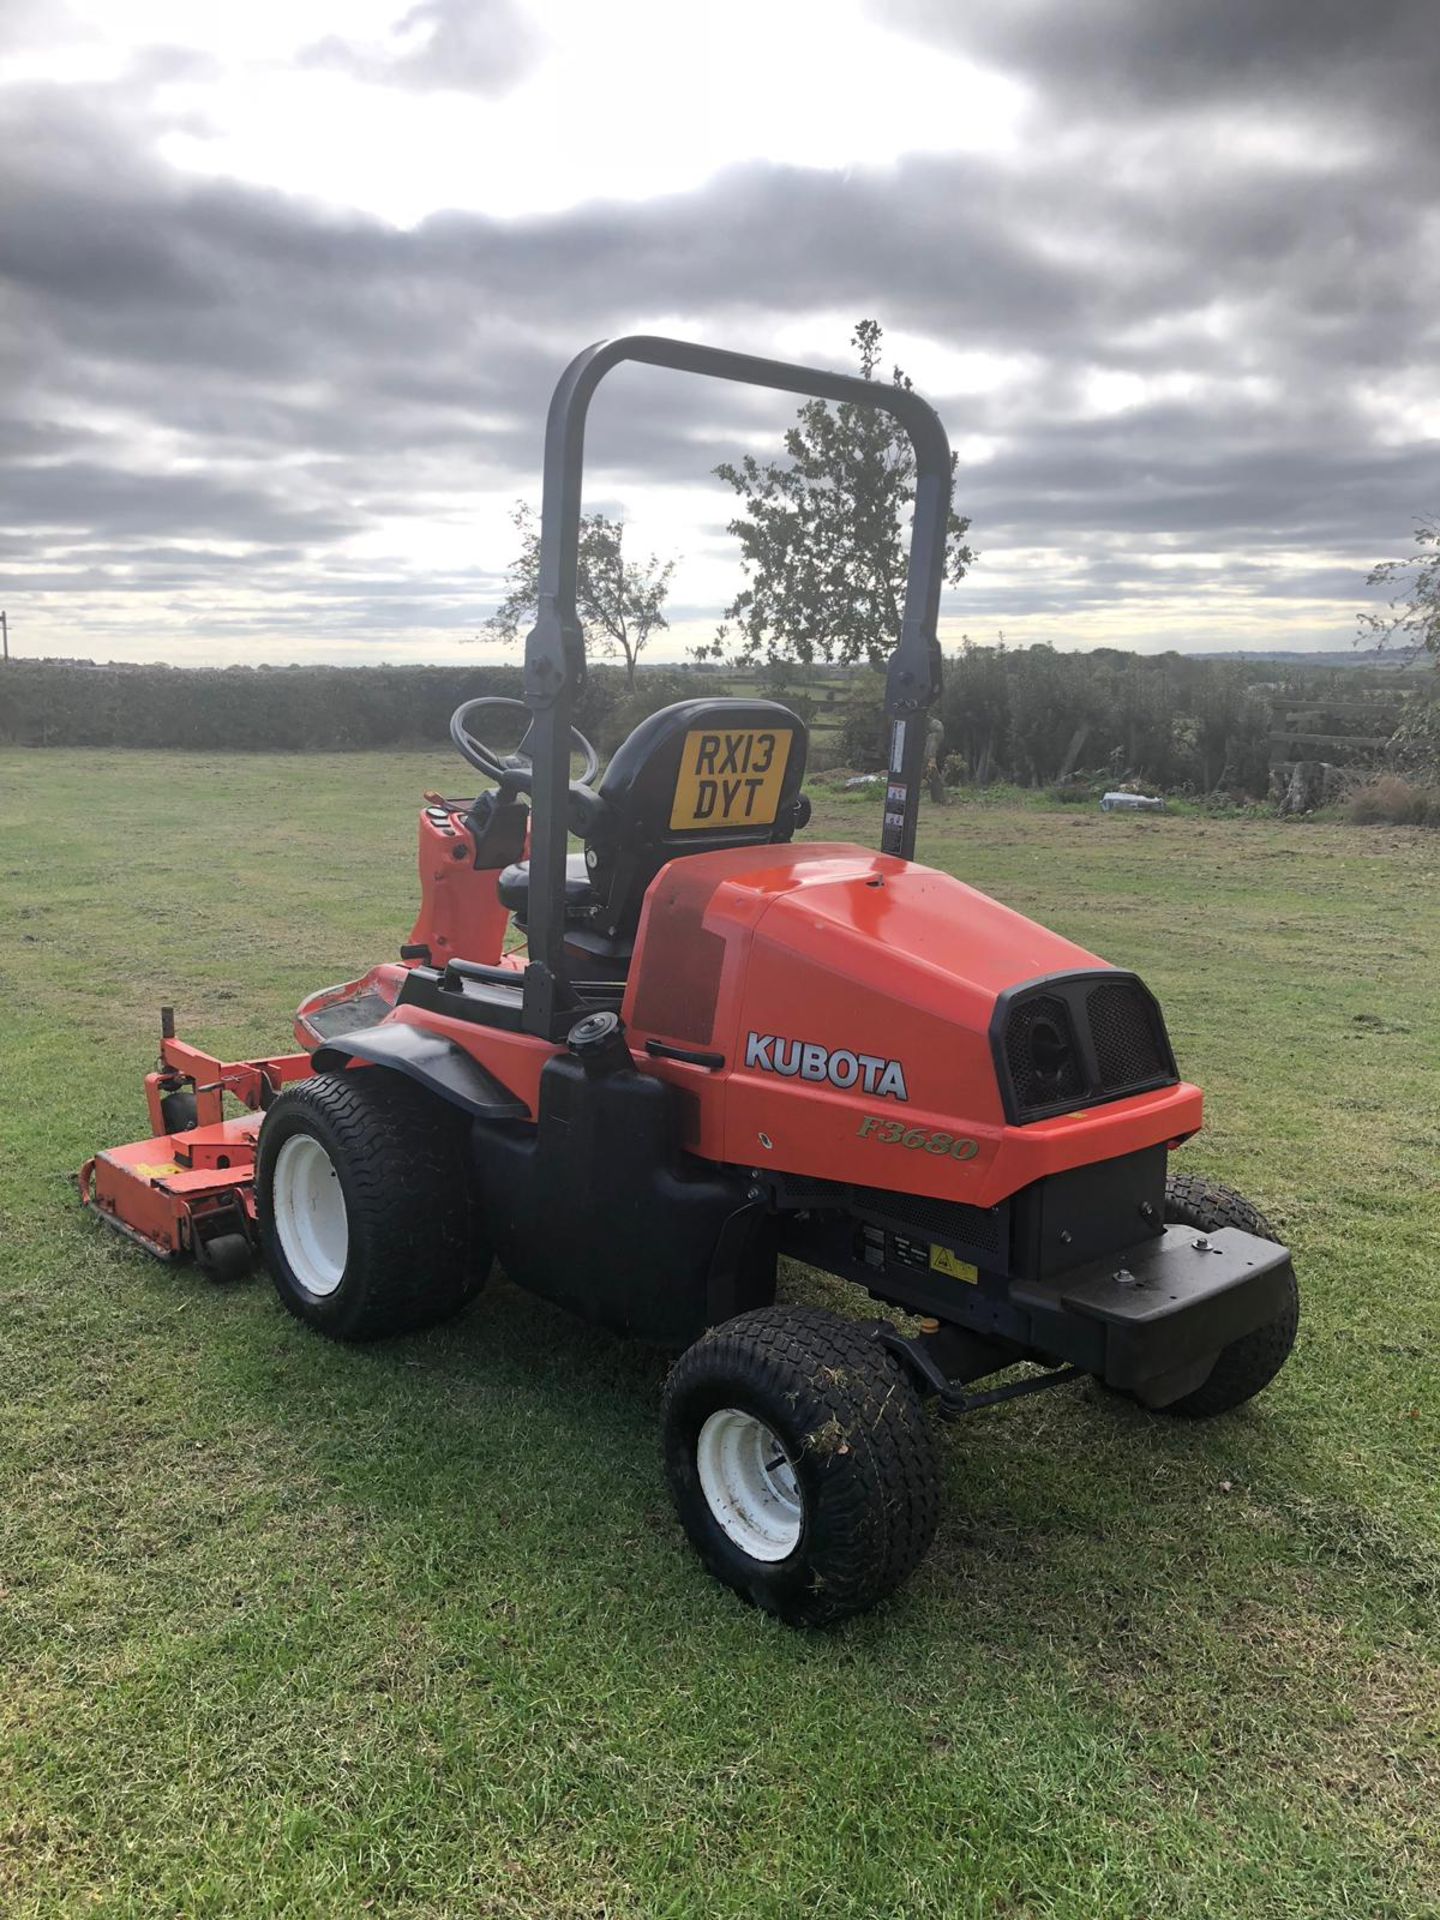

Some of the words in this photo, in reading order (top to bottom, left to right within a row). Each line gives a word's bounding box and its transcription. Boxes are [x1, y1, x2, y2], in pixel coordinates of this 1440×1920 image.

[695, 734, 776, 775] RX13
[693, 779, 764, 819] DYT
[744, 1030, 908, 1101] KUBOTA
[856, 1116, 979, 1161] F3680
